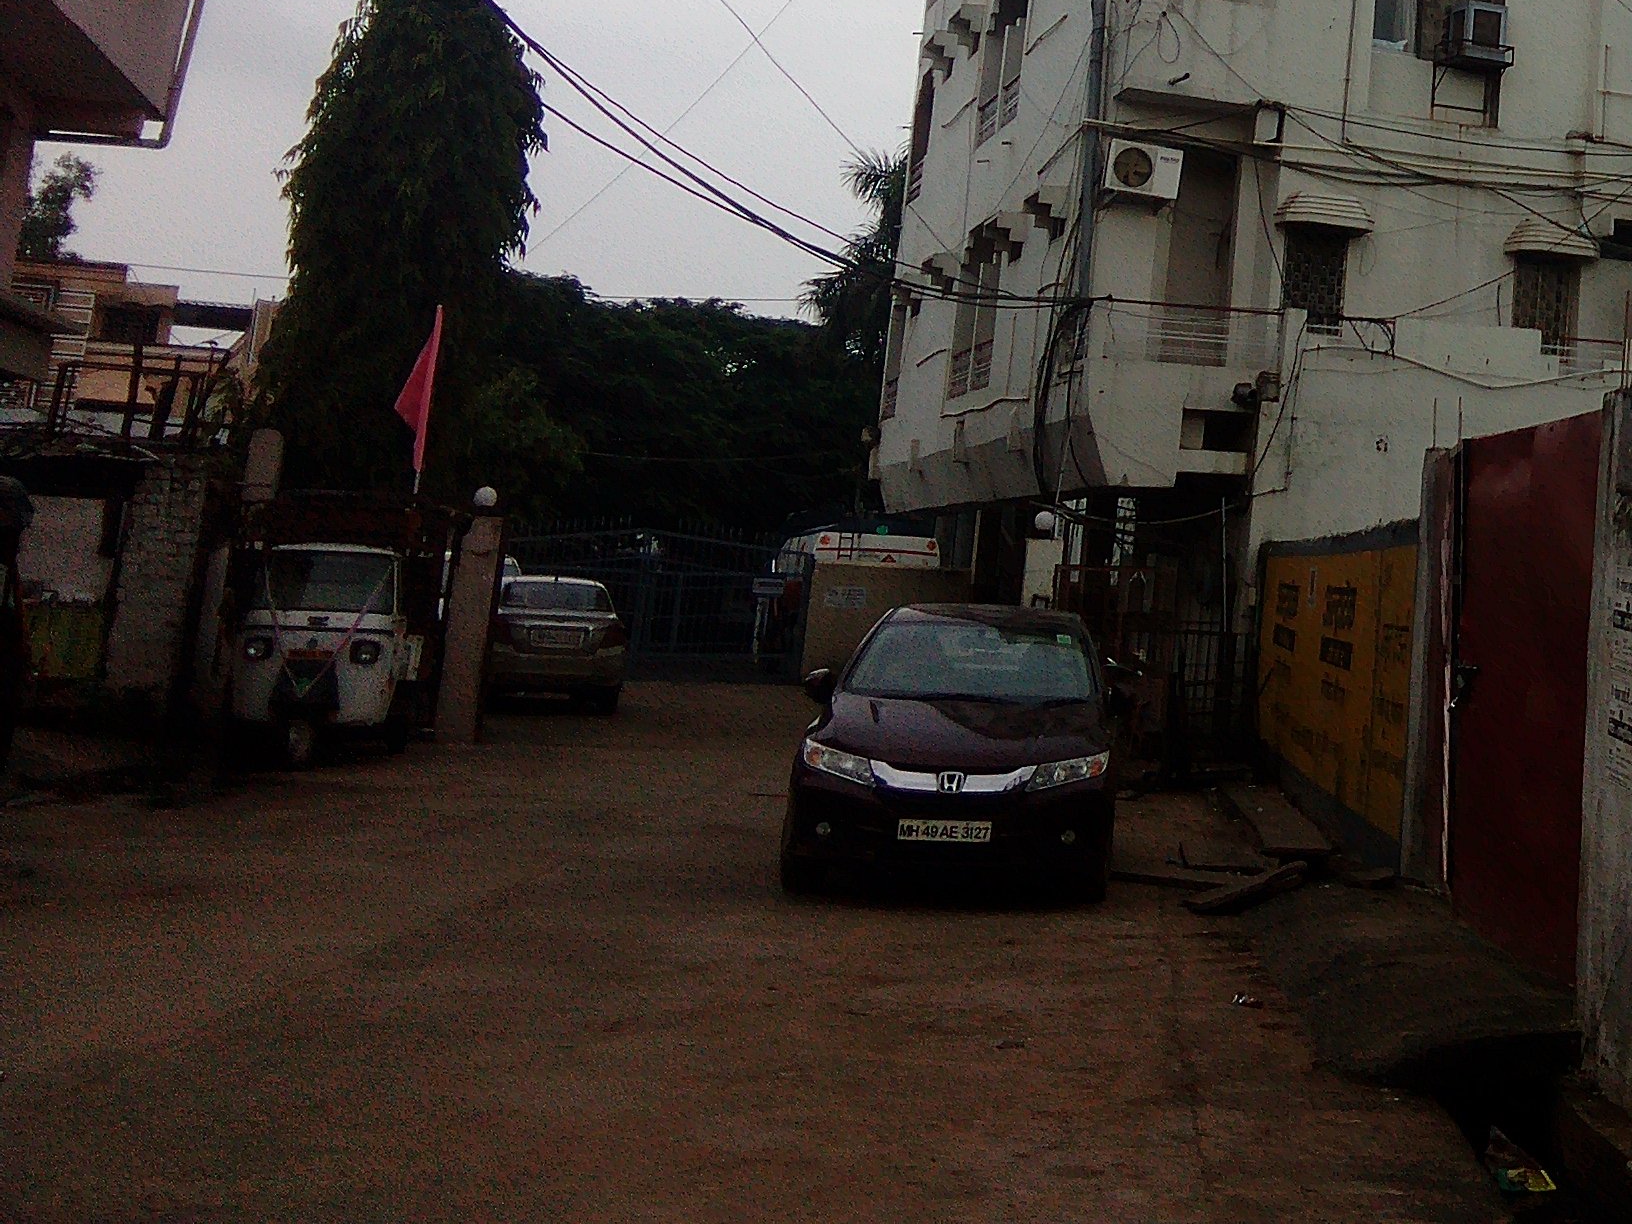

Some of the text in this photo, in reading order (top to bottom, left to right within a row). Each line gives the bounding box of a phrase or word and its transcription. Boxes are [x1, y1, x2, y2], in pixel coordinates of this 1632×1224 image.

[899, 823, 990, 840] MH 49 AE 3127
